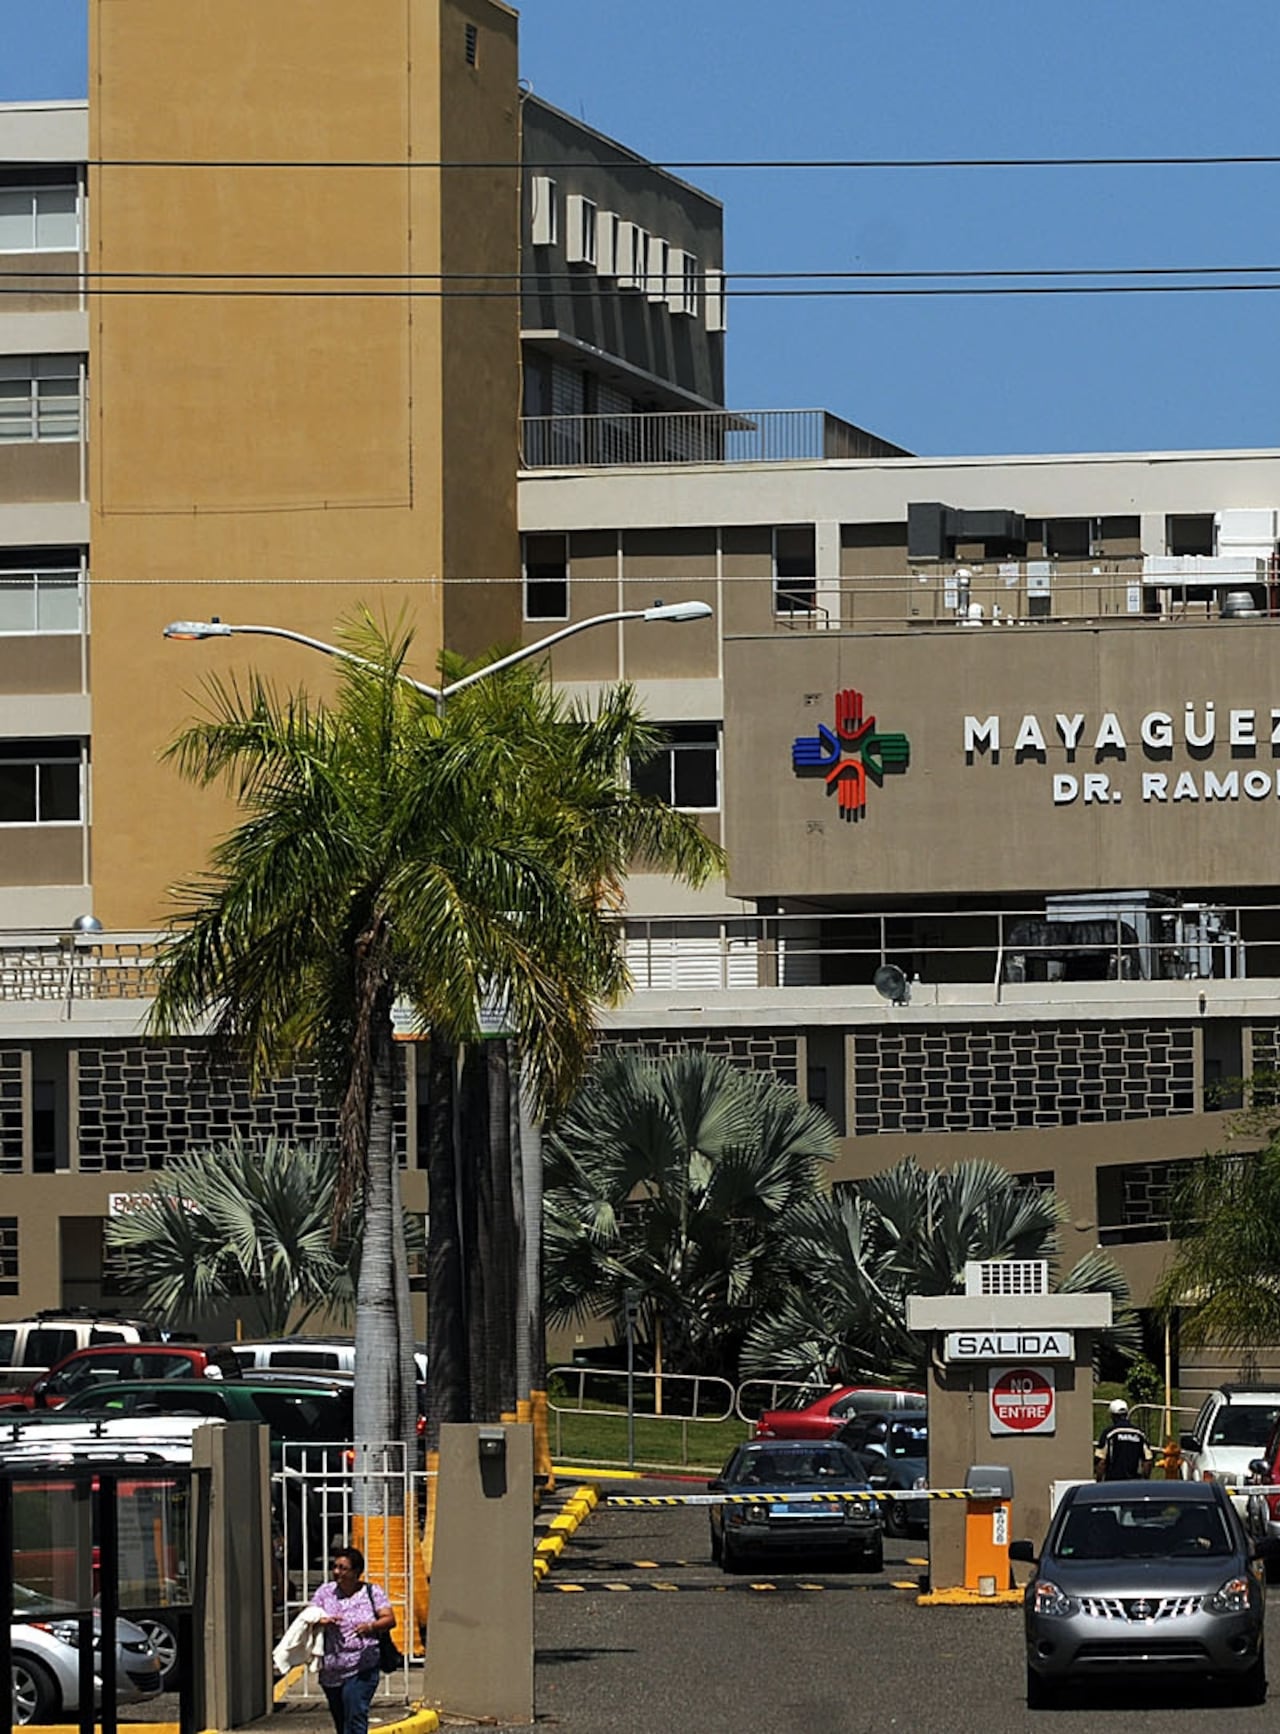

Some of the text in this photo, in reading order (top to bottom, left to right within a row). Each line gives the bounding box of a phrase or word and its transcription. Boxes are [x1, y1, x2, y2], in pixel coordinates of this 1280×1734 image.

[1053, 773, 1122, 802] DR.
[958, 1336, 1060, 1355] SALIDA
[1010, 1378, 1034, 1393] NO
[999, 1405, 1046, 1419] ENTRE
